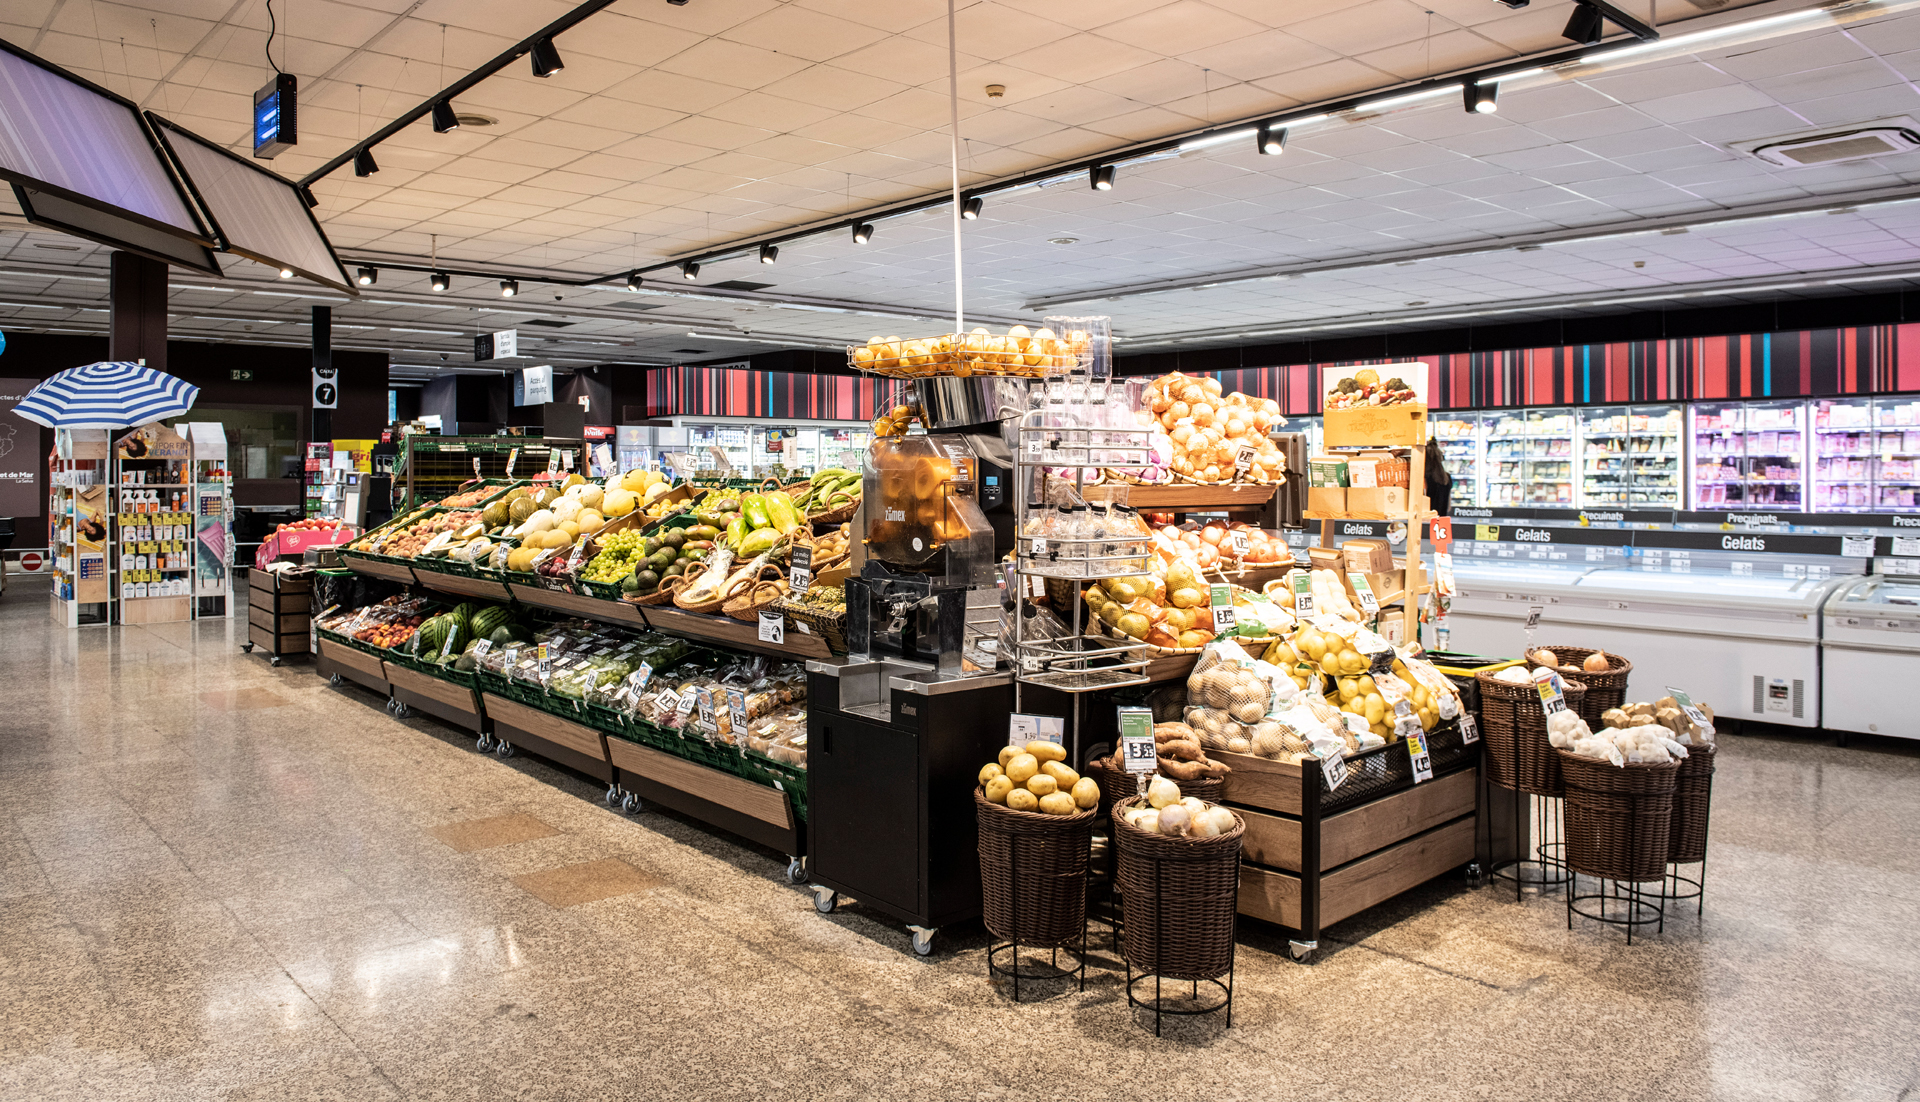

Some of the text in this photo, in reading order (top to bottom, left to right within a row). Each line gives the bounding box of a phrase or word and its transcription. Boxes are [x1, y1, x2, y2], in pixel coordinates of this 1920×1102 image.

[322, 388, 332, 400] 7
[1454, 508, 1493, 517] Precuinats
[1727, 512, 1778, 524] Precuinats
[1343, 523, 1373, 536] Gelats
[1515, 528, 1551, 542] Gelats
[1721, 535, 1766, 550] Gelats
[1132, 743, 1154, 758] 3,25
